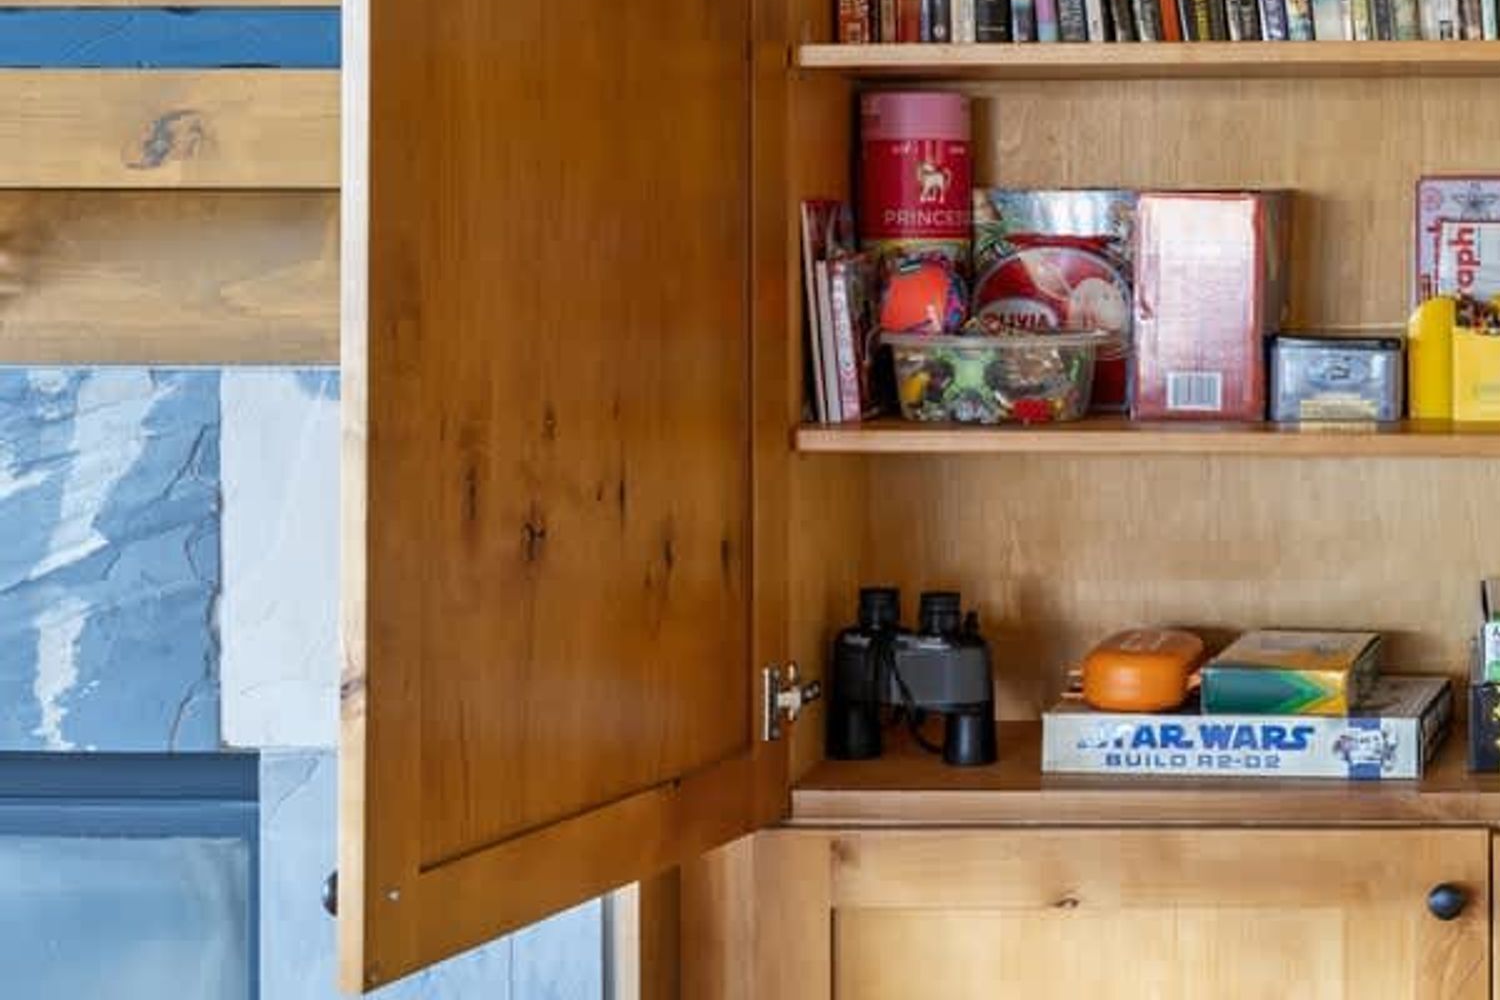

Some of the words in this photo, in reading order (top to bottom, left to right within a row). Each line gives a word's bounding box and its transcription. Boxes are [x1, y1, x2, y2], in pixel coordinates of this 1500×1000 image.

[982, 312, 1054, 335] OLIVIA
[1199, 724, 1315, 750] WARS
[1105, 753, 1187, 767] BUILD
[1197, 753, 1281, 768] R2-D2
